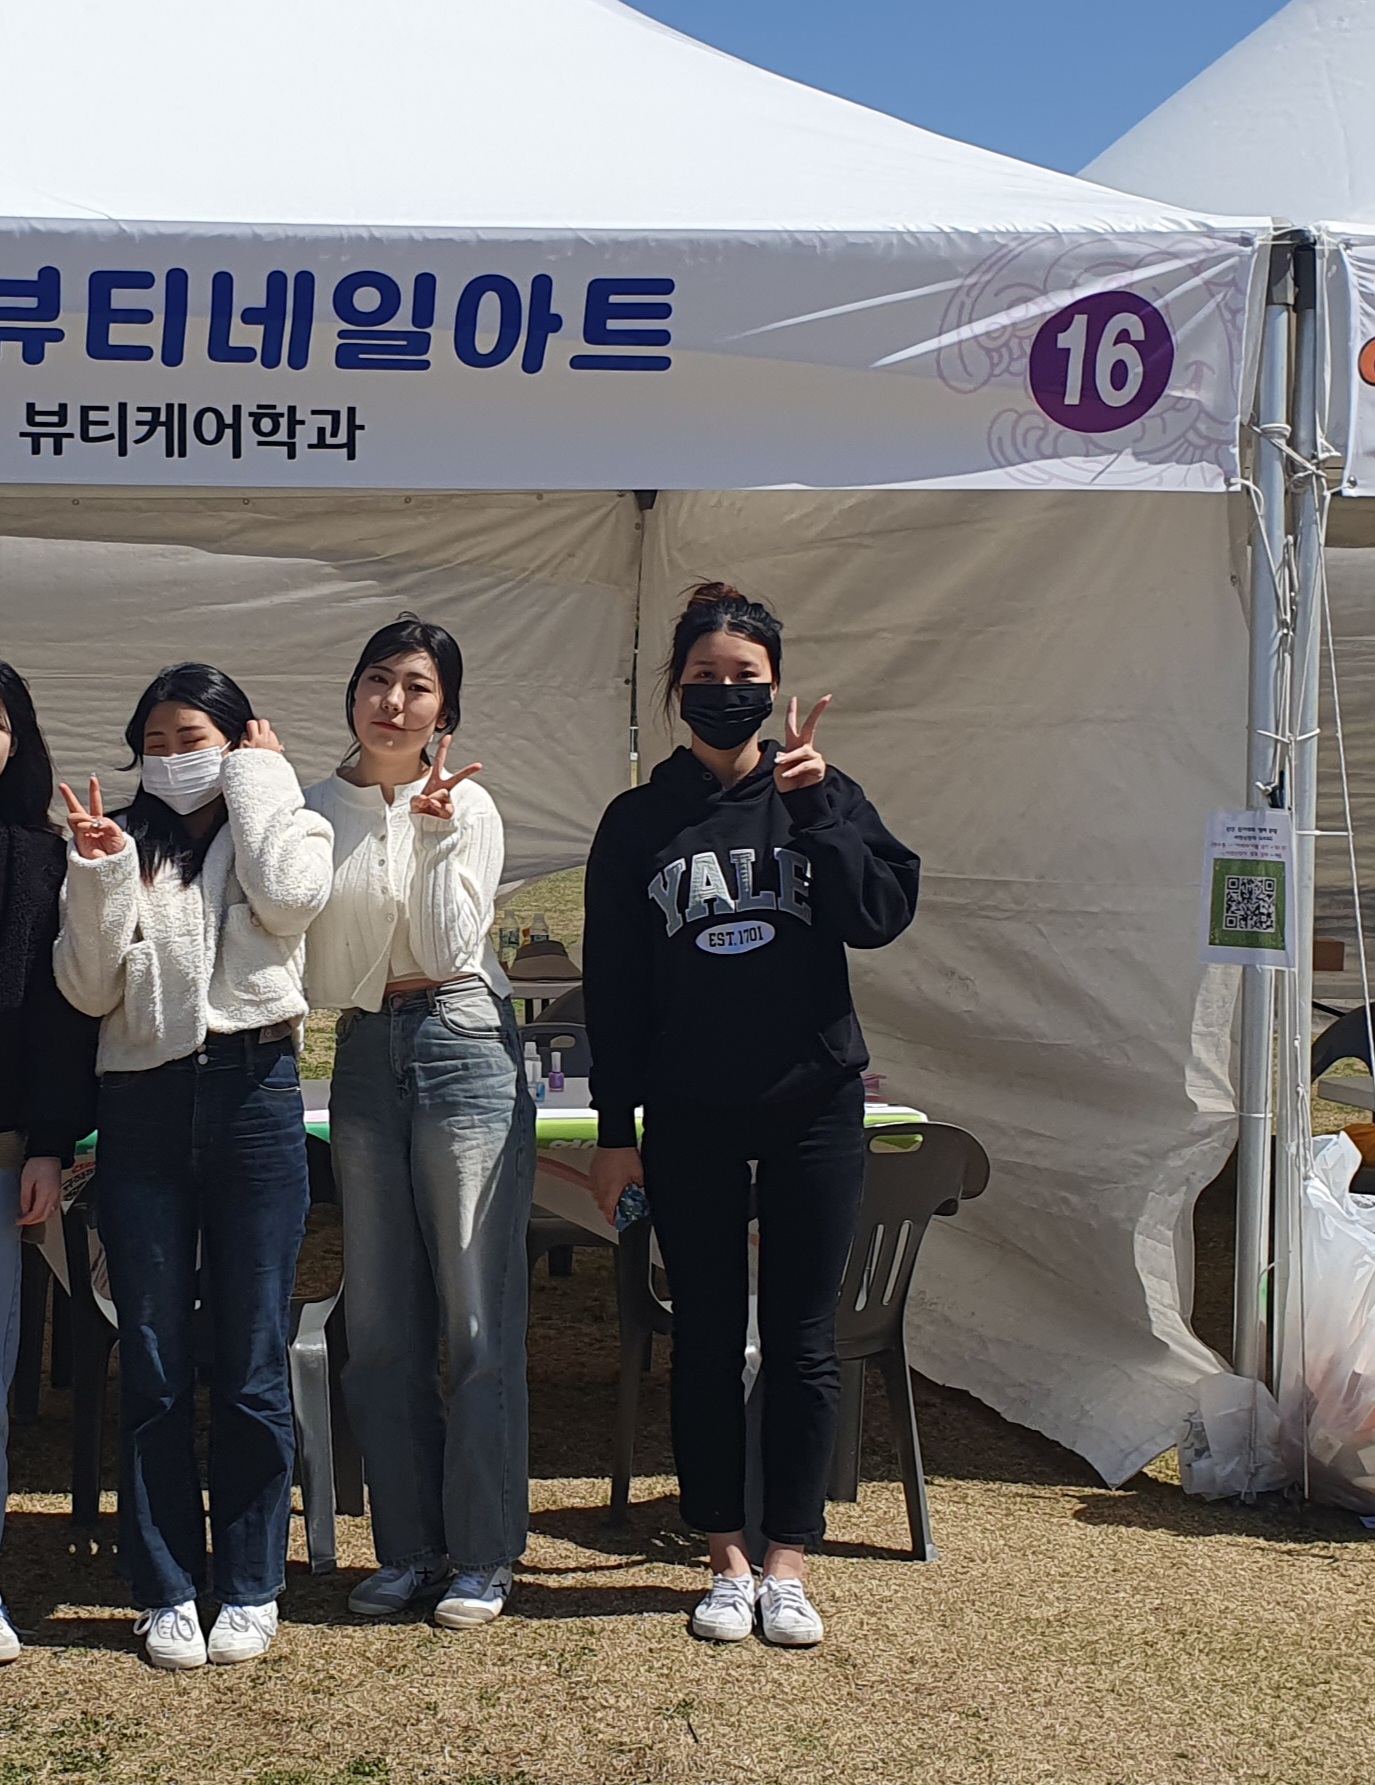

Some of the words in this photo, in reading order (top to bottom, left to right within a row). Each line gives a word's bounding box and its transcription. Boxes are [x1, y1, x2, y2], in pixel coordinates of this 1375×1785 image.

[1056, 312, 1146, 408] 16
[19, 400, 366, 461] 뷰티케어학과
[648, 847, 812, 938] YALE
